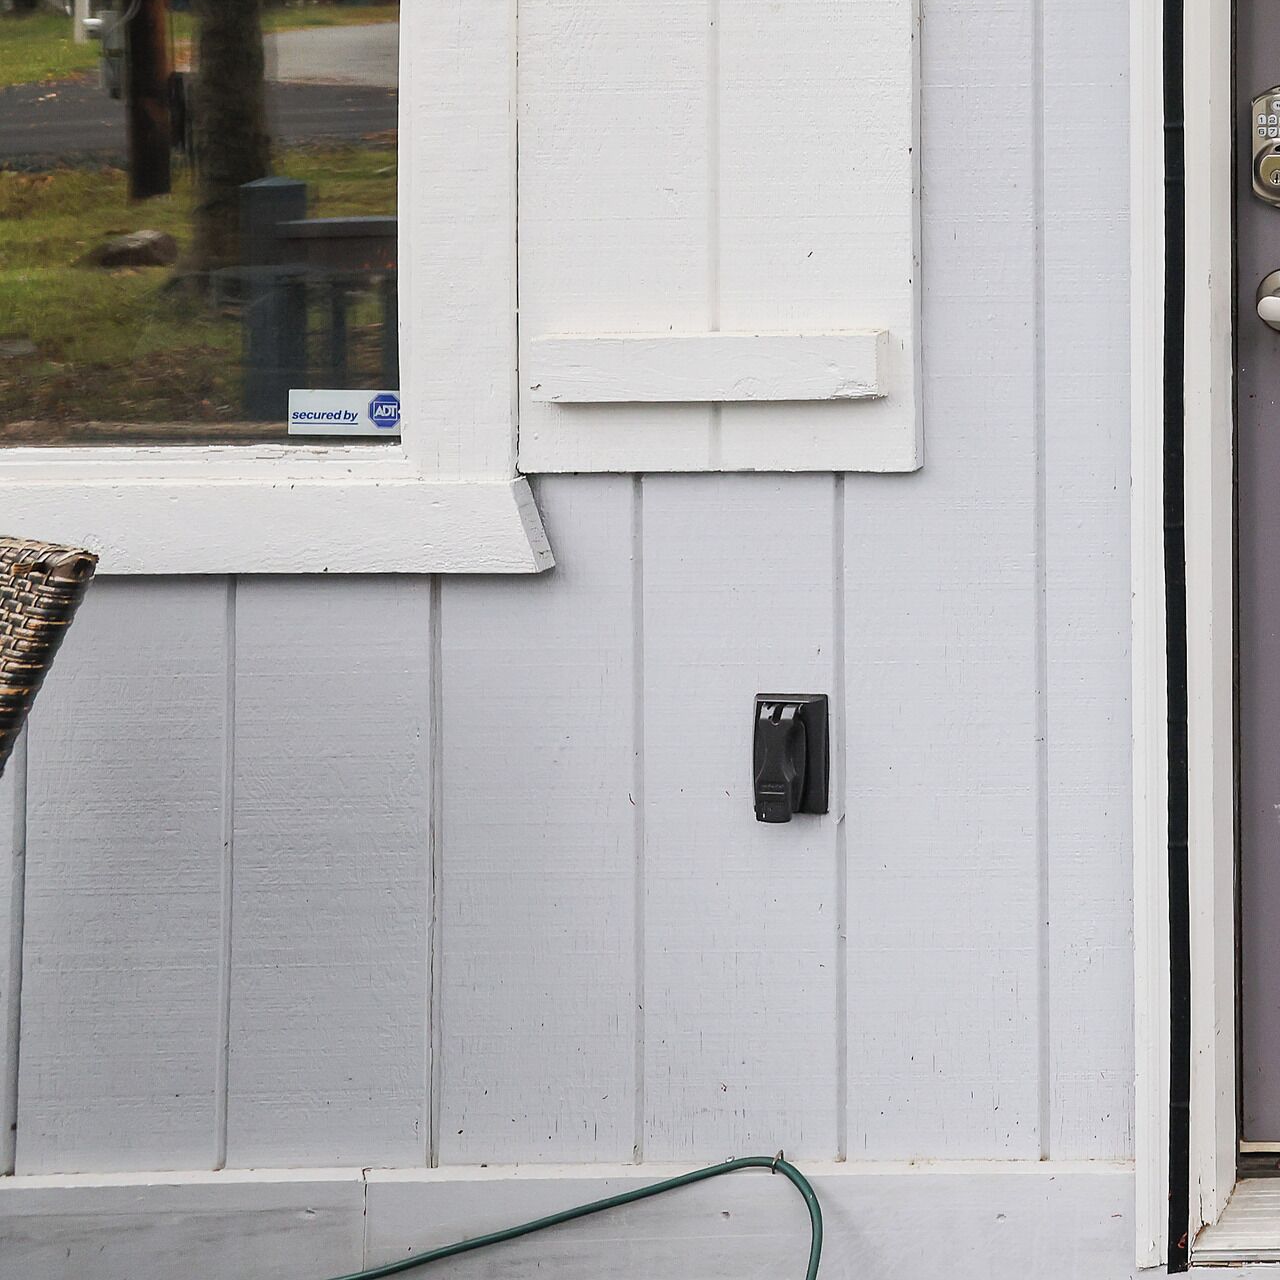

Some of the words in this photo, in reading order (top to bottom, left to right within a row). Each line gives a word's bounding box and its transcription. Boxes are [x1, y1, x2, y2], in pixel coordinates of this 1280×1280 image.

[291, 409, 342, 420] secured
[343, 409, 359, 422] by
[373, 404, 397, 418] ADT
